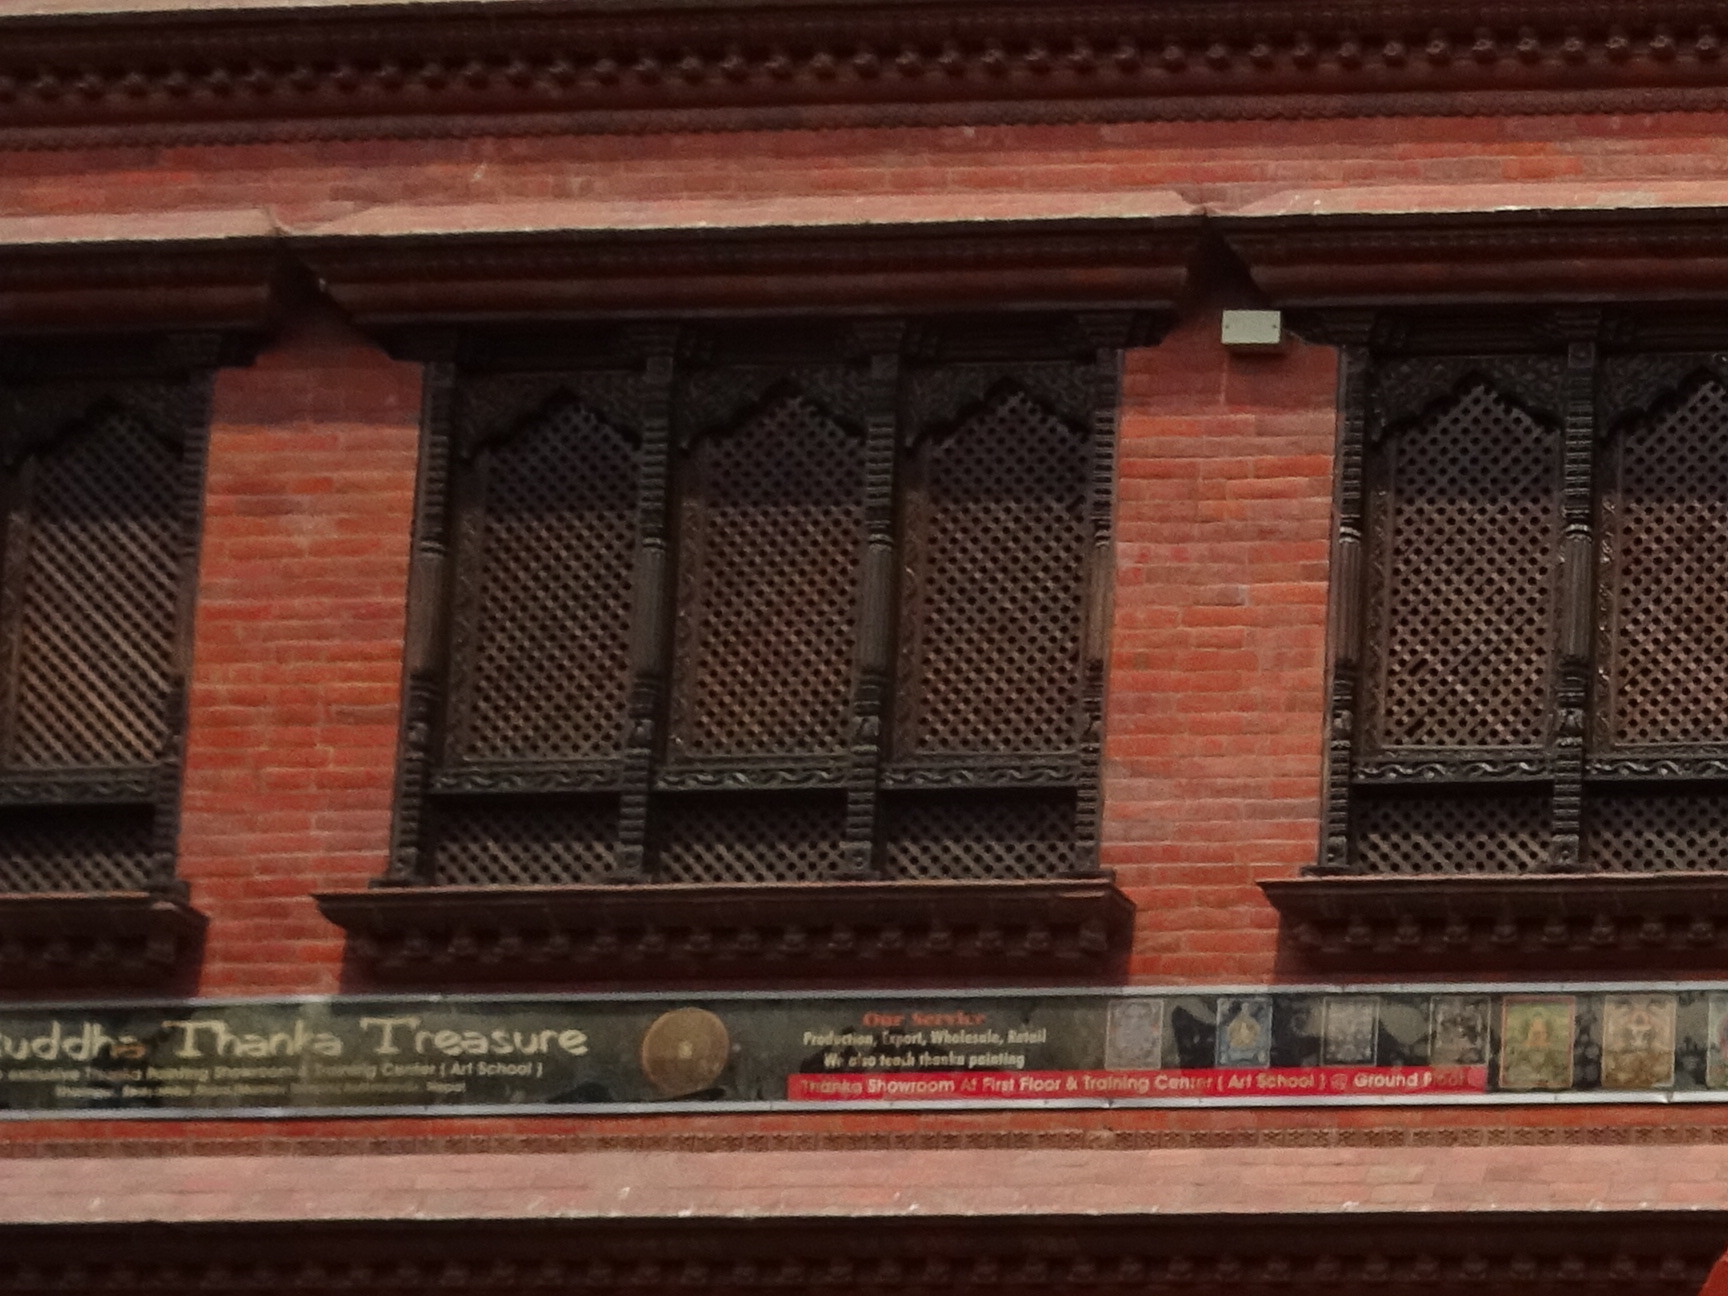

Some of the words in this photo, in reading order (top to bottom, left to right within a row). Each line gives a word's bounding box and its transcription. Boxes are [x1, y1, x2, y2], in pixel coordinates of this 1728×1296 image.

[0, 1020, 147, 1060] uddha
[161, 1018, 343, 1058] Thanka
[359, 1016, 588, 1056] Treasure
[1007, 1027, 1047, 1044] Retail
[450, 1062, 473, 1076] Art
[479, 1061, 532, 1076] School
[968, 1051, 1026, 1069] painting
[867, 1078, 955, 1095] Showroom
[982, 1076, 1015, 1092] First
[1020, 1076, 1061, 1092] Floor
[1065, 1075, 1078, 1091] &
[1083, 1074, 1150, 1094] Training
[1227, 1073, 1252, 1089] Art
[1256, 1072, 1315, 1089] School
[1353, 1071, 1419, 1088] Ground
